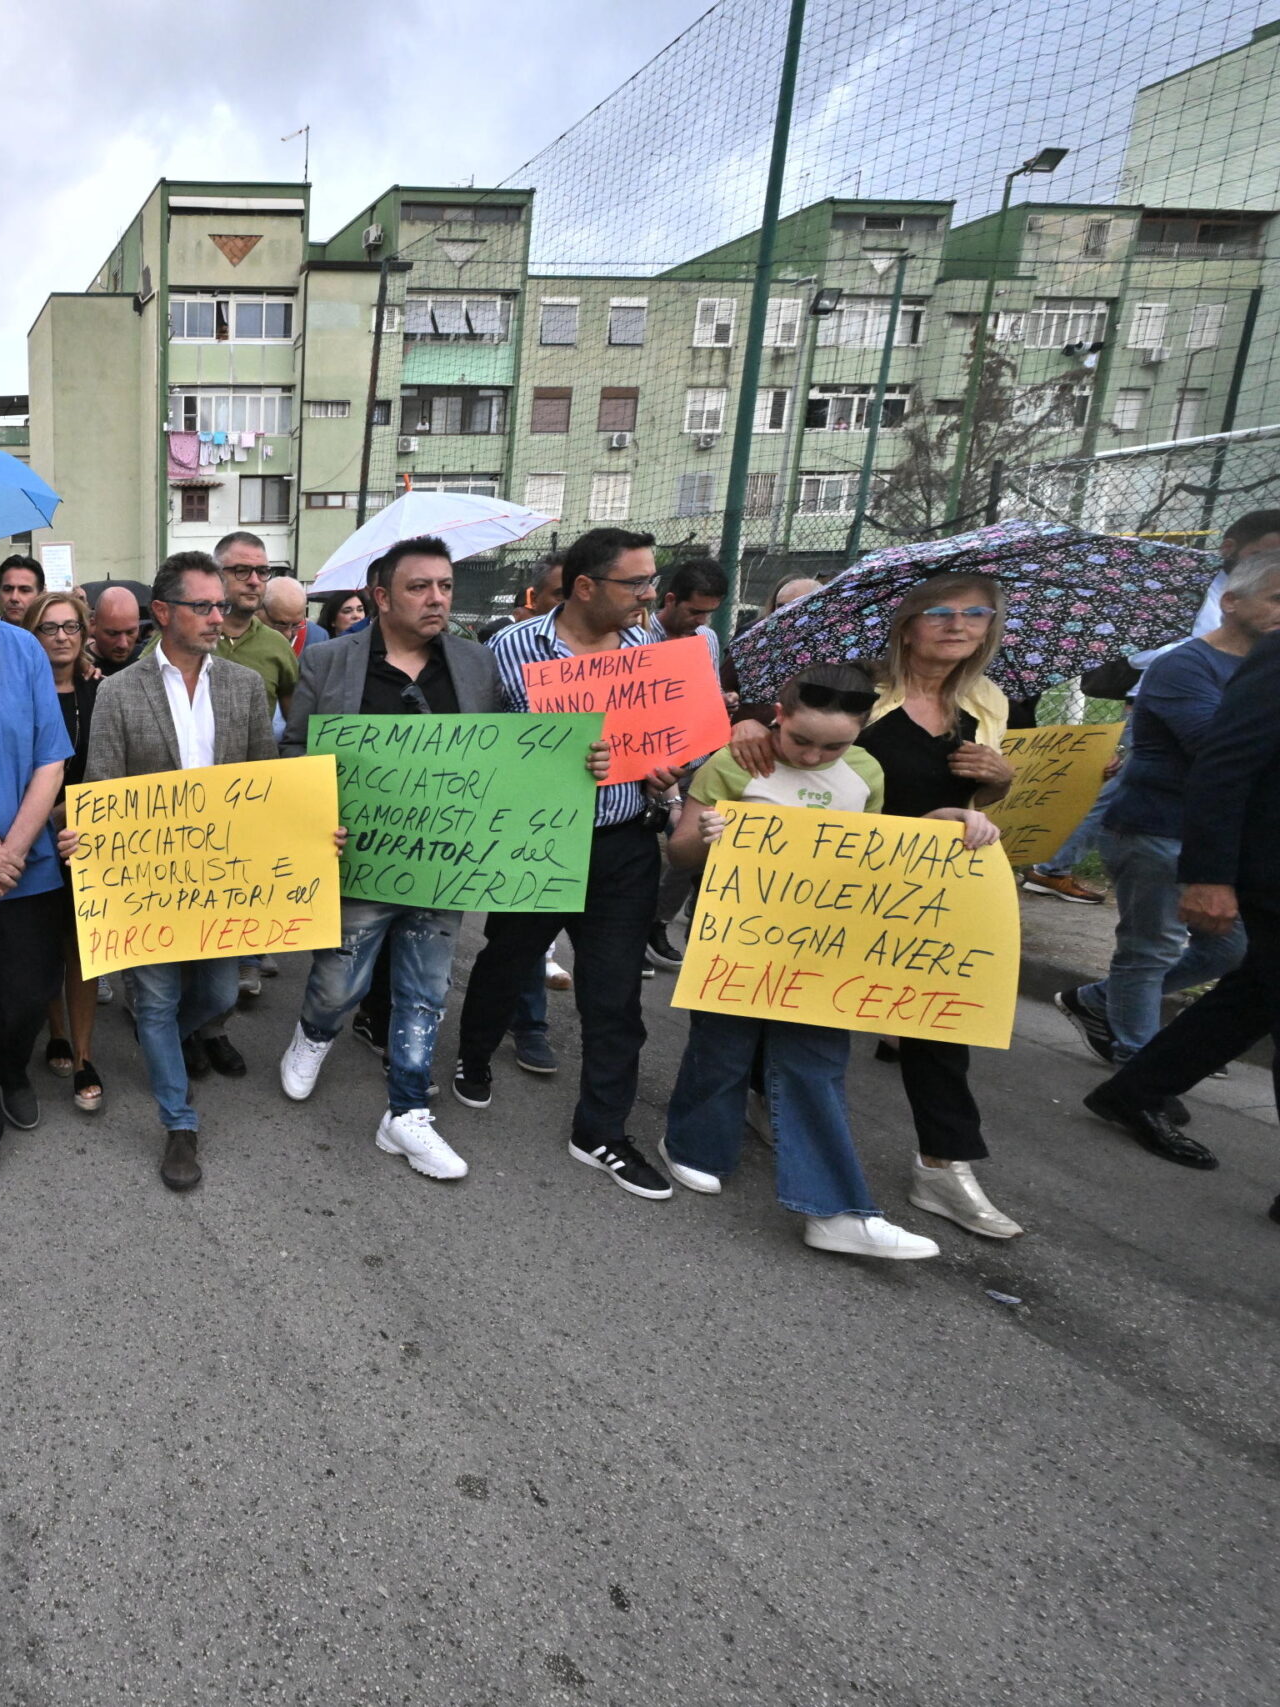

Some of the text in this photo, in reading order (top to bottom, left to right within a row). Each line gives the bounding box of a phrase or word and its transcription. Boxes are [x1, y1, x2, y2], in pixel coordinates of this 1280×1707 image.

[526, 649, 657, 688] LE BAMBINE
[535, 678, 686, 713] VANNO AMATE
[316, 716, 499, 760] FERMIAMO
[608, 726, 690, 757] PRATE
[1000, 732, 1107, 756] ERMARE
[75, 776, 272, 826] FERMIAMO GLI
[337, 763, 498, 806] PACCIATORI
[341, 800, 477, 835] CAMORRISTI
[489, 808, 512, 832] E
[75, 821, 231, 861] SPACCIATORI
[346, 828, 568, 869] UPRATORI del
[716, 808, 789, 855] PER
[812, 822, 985, 879] FERMARE
[78, 857, 293, 892] I CAMORRISTI E
[340, 864, 581, 910] ARCO VERDE
[705, 864, 951, 928] LA VIOLENZA
[78, 877, 320, 921] GLI STUPRATORI del
[90, 918, 313, 965] PARCO VERDE
[699, 912, 995, 978] BISOGNA AVERE
[699, 954, 985, 1030] PENE CERTE
